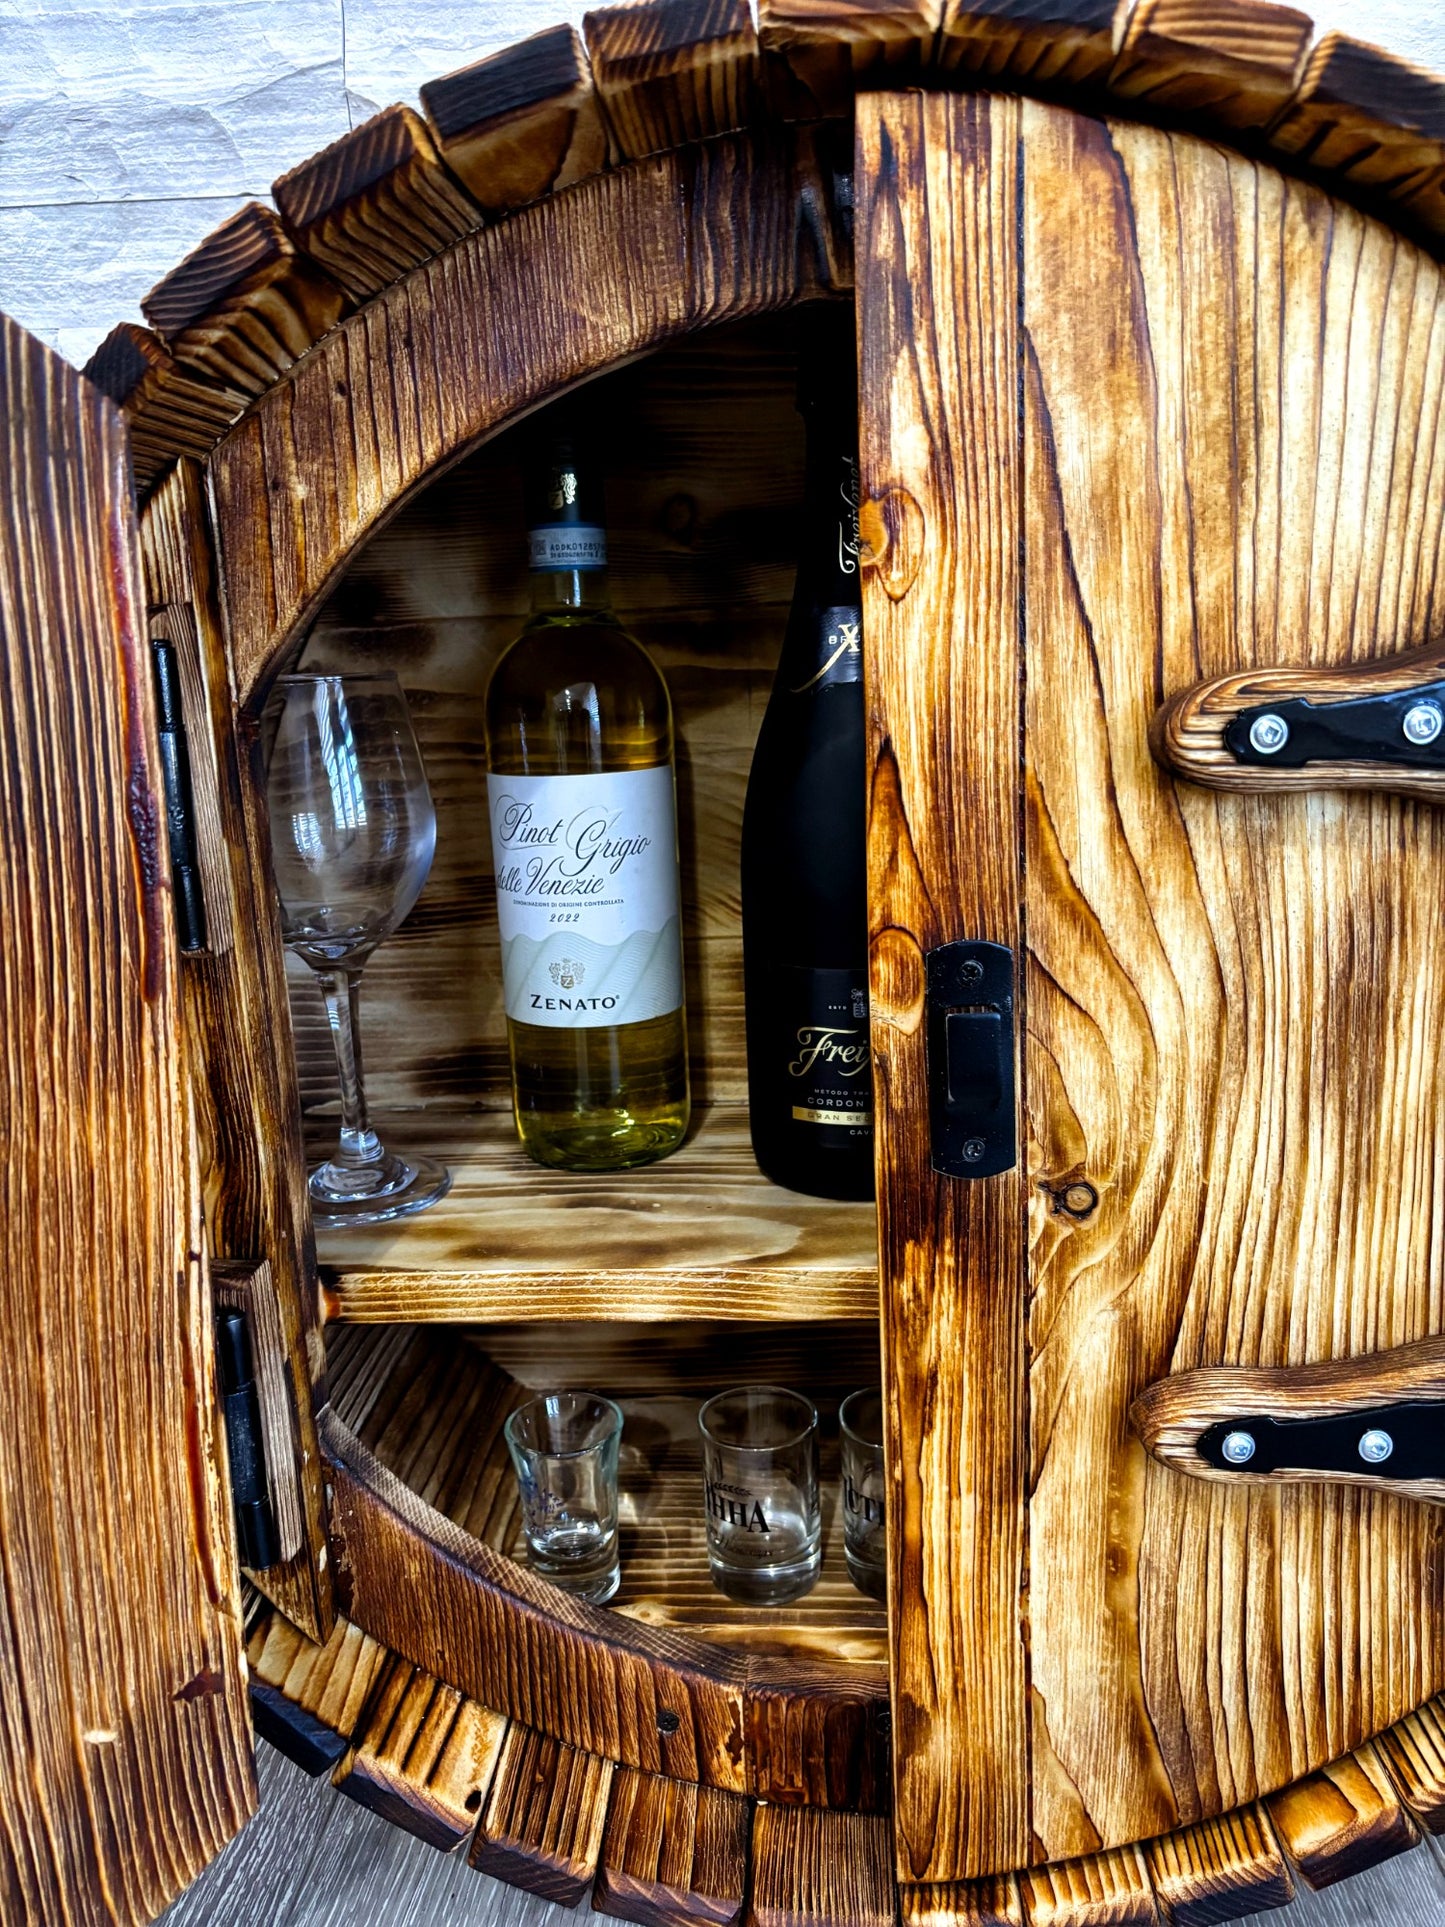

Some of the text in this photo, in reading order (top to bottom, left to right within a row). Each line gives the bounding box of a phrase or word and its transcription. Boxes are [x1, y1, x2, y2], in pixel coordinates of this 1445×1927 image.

[495, 795, 651, 877] Pinot Grigio
[497, 856, 605, 896] delle Venezie
[584, 899, 624, 907] CONTROLLATA
[549, 912, 580, 923] 2022
[530, 993, 617, 1011] ZENATO
[814, 1088, 849, 1096] METODO
[807, 1096, 864, 1107] CORDON
[807, 1111, 840, 1121] GRAN
